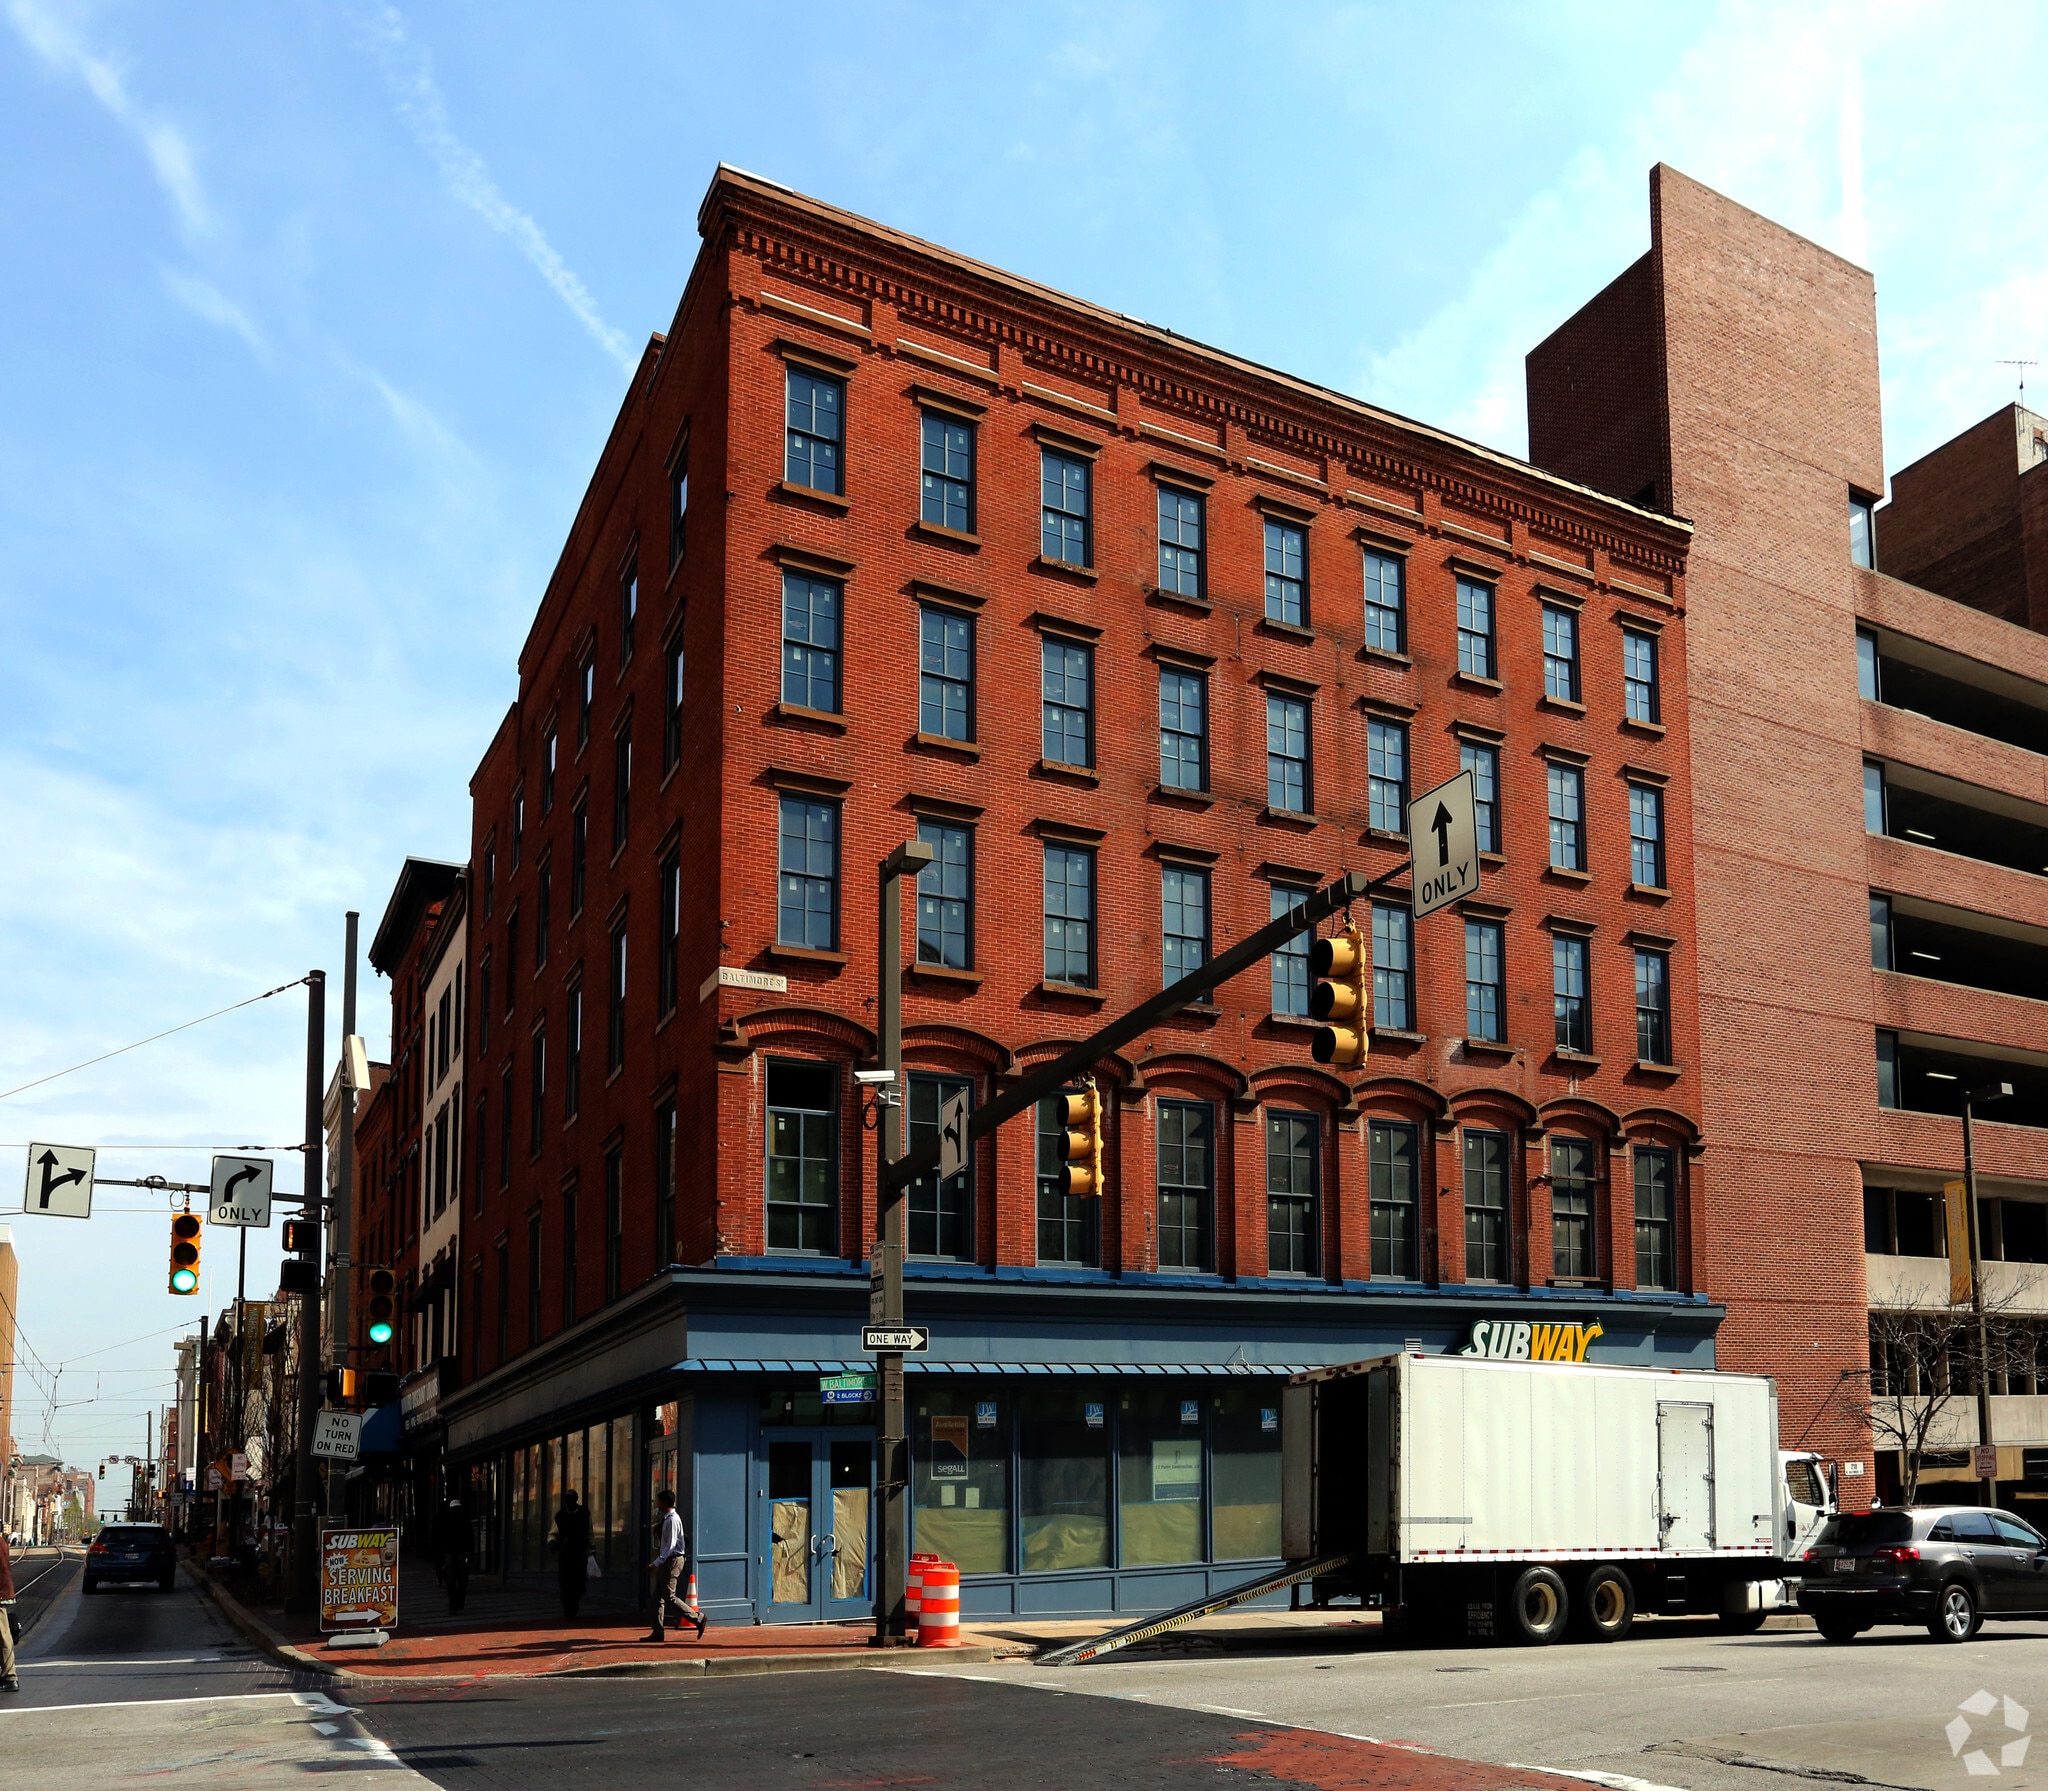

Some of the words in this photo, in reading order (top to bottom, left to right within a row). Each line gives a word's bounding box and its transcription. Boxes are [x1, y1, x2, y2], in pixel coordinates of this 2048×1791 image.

[1422, 861, 1469, 905] ONLY
[722, 972, 773, 986] BALTIMORE
[218, 1206, 262, 1221] ONLY
[869, 1334, 889, 1344] ONE
[893, 1334, 913, 1344] WAY
[1460, 1319, 1603, 1363] SUBWAY
[821, 1380, 829, 1390] W
[830, 1376, 867, 1389] BALTIMORE
[331, 1417, 349, 1428] NO
[935, 1421, 966, 1429] Available
[325, 1429, 352, 1441] TURN
[316, 1441, 331, 1451] ON
[335, 1443, 355, 1454] RED
[325, 1532, 395, 1550] SUBWAY
[329, 1557, 345, 1567] NOW
[329, 1567, 392, 1586] SERVING
[324, 1586, 395, 1605] BREAKFAST
[1467, 1610, 1493, 1620] EFFICIENCY
